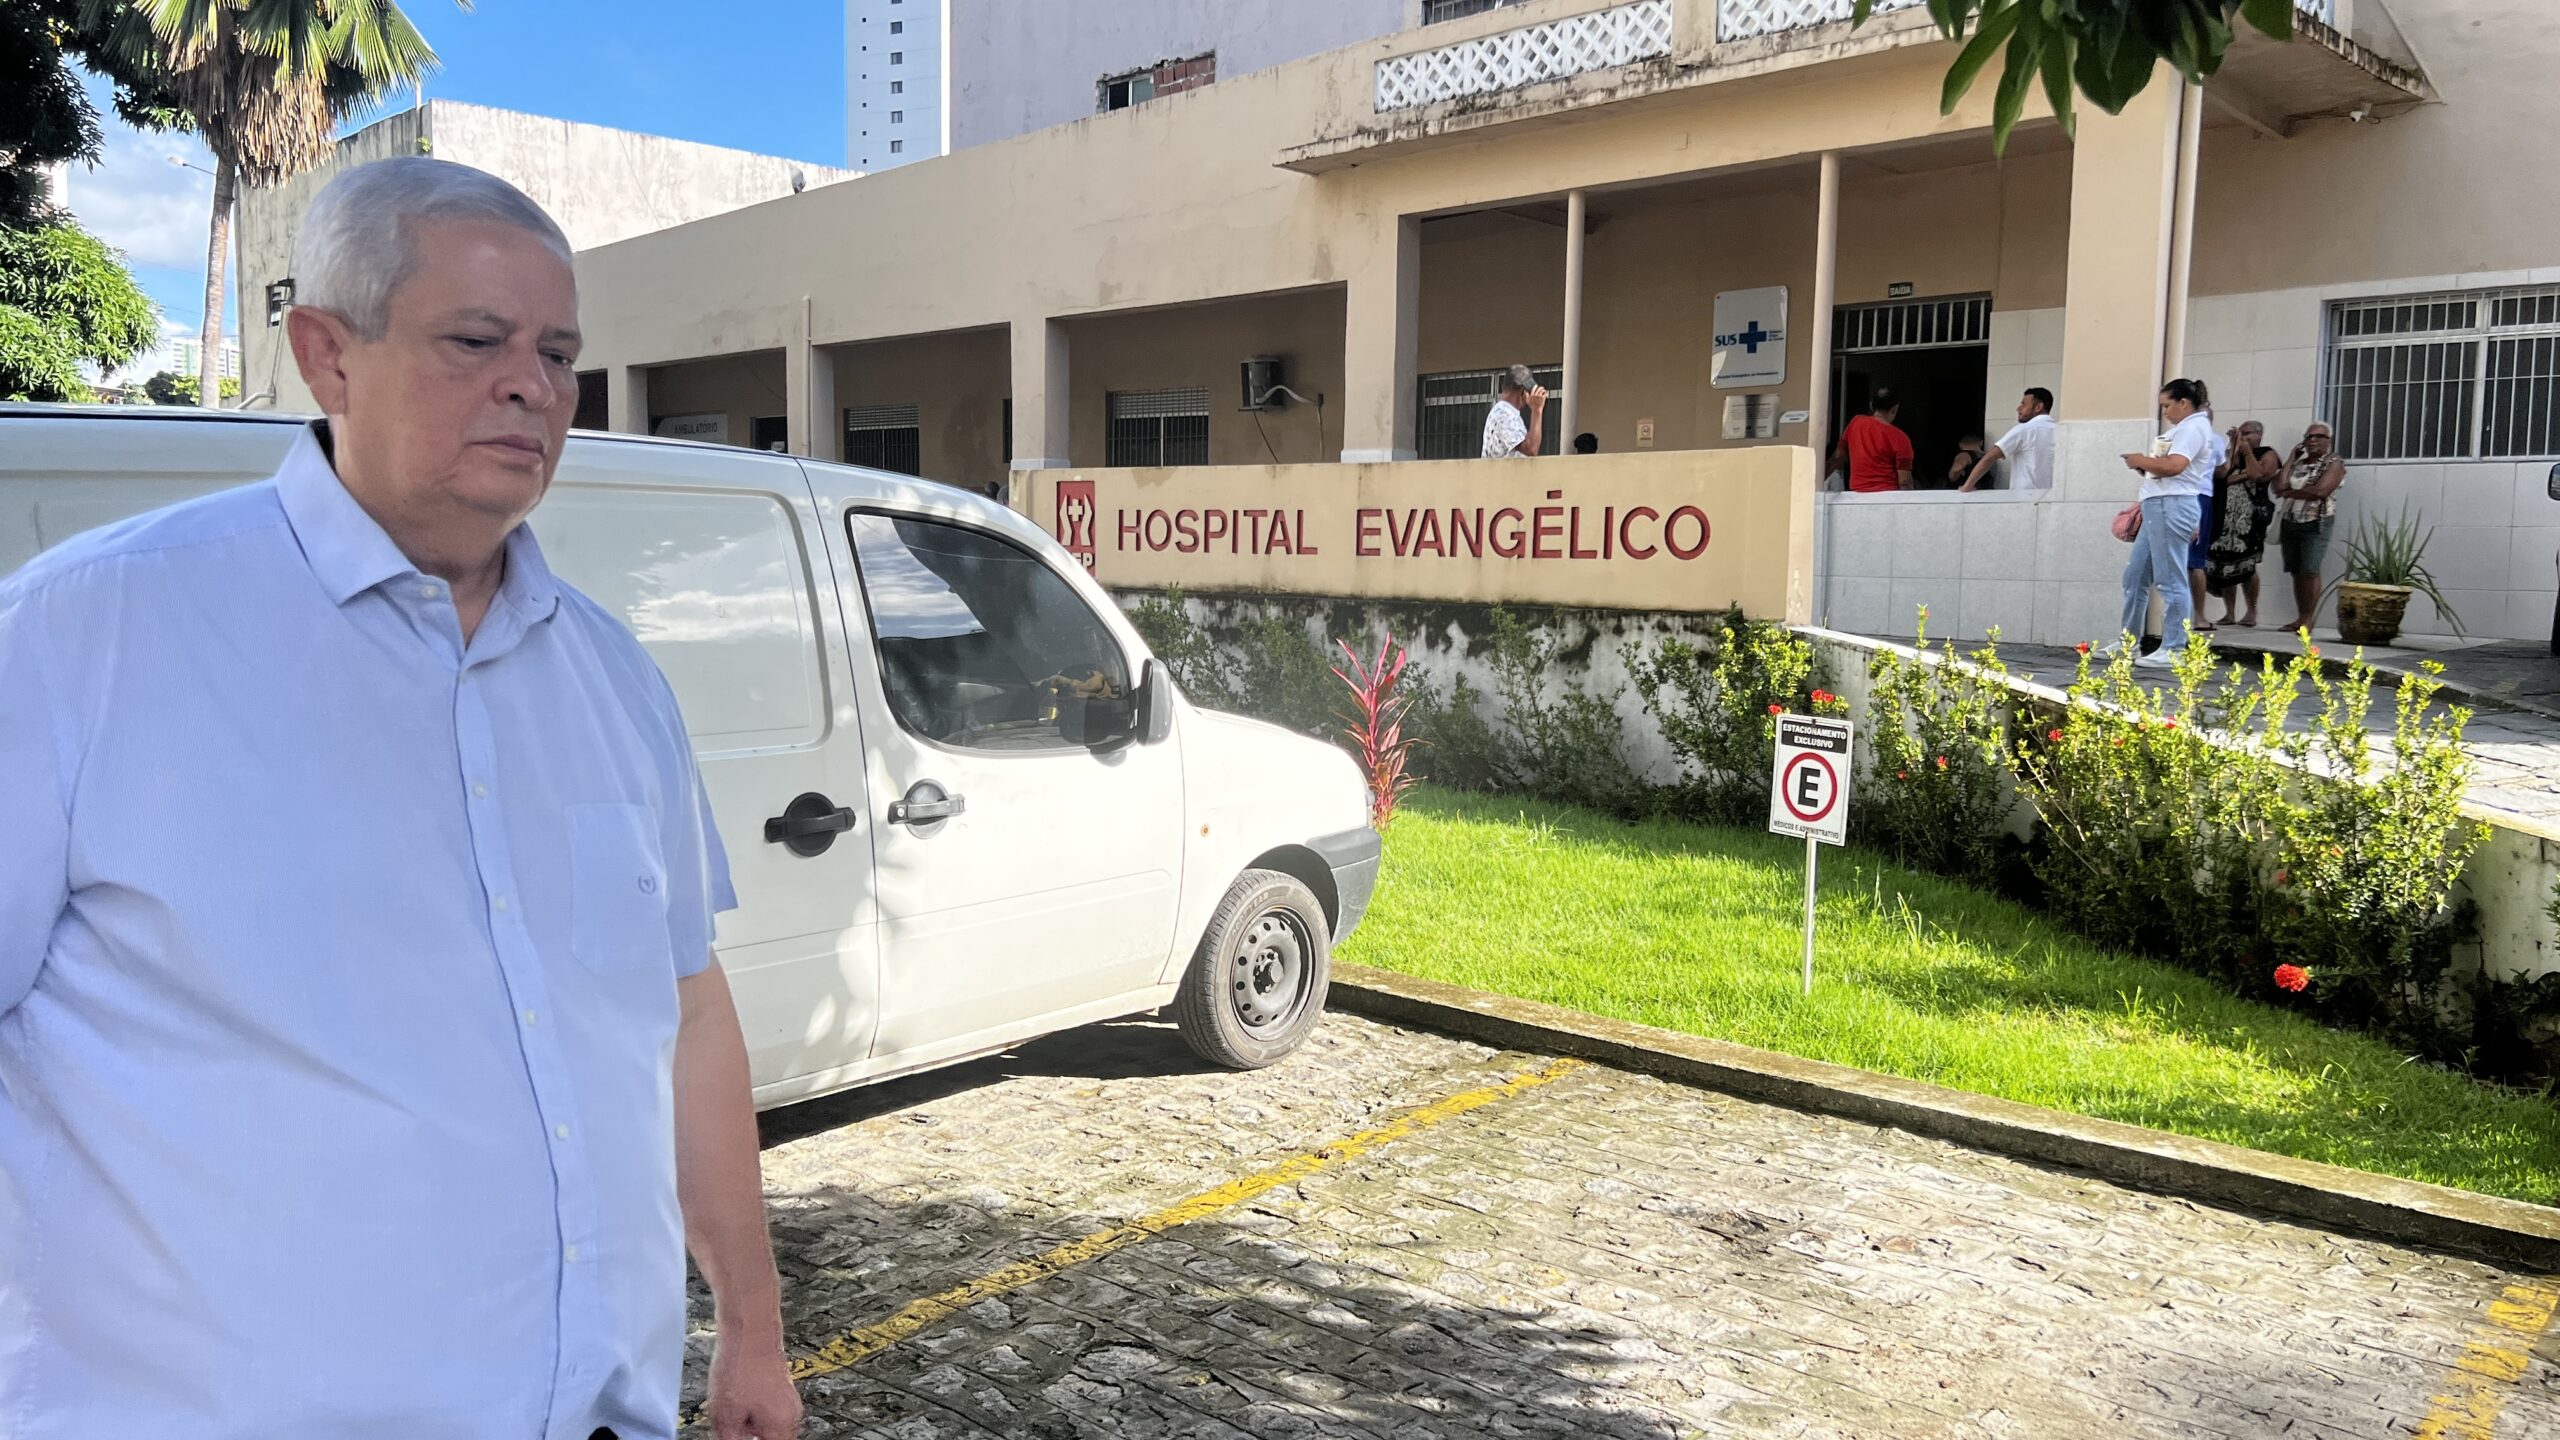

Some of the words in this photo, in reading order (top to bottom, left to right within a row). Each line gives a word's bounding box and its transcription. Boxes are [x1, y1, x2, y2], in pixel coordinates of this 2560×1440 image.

[1715, 333, 1737, 347] SUS
[675, 420, 718, 433] AMBULATÓRIO
[1117, 507, 1319, 556] HOSPITAL
[1355, 489, 1712, 561] EVANGÉLICO
[1782, 723, 1847, 739] ESTACIONAMENTO
[1794, 735, 1834, 749] EXCLUSIVO
[1797, 766, 1821, 808] E
